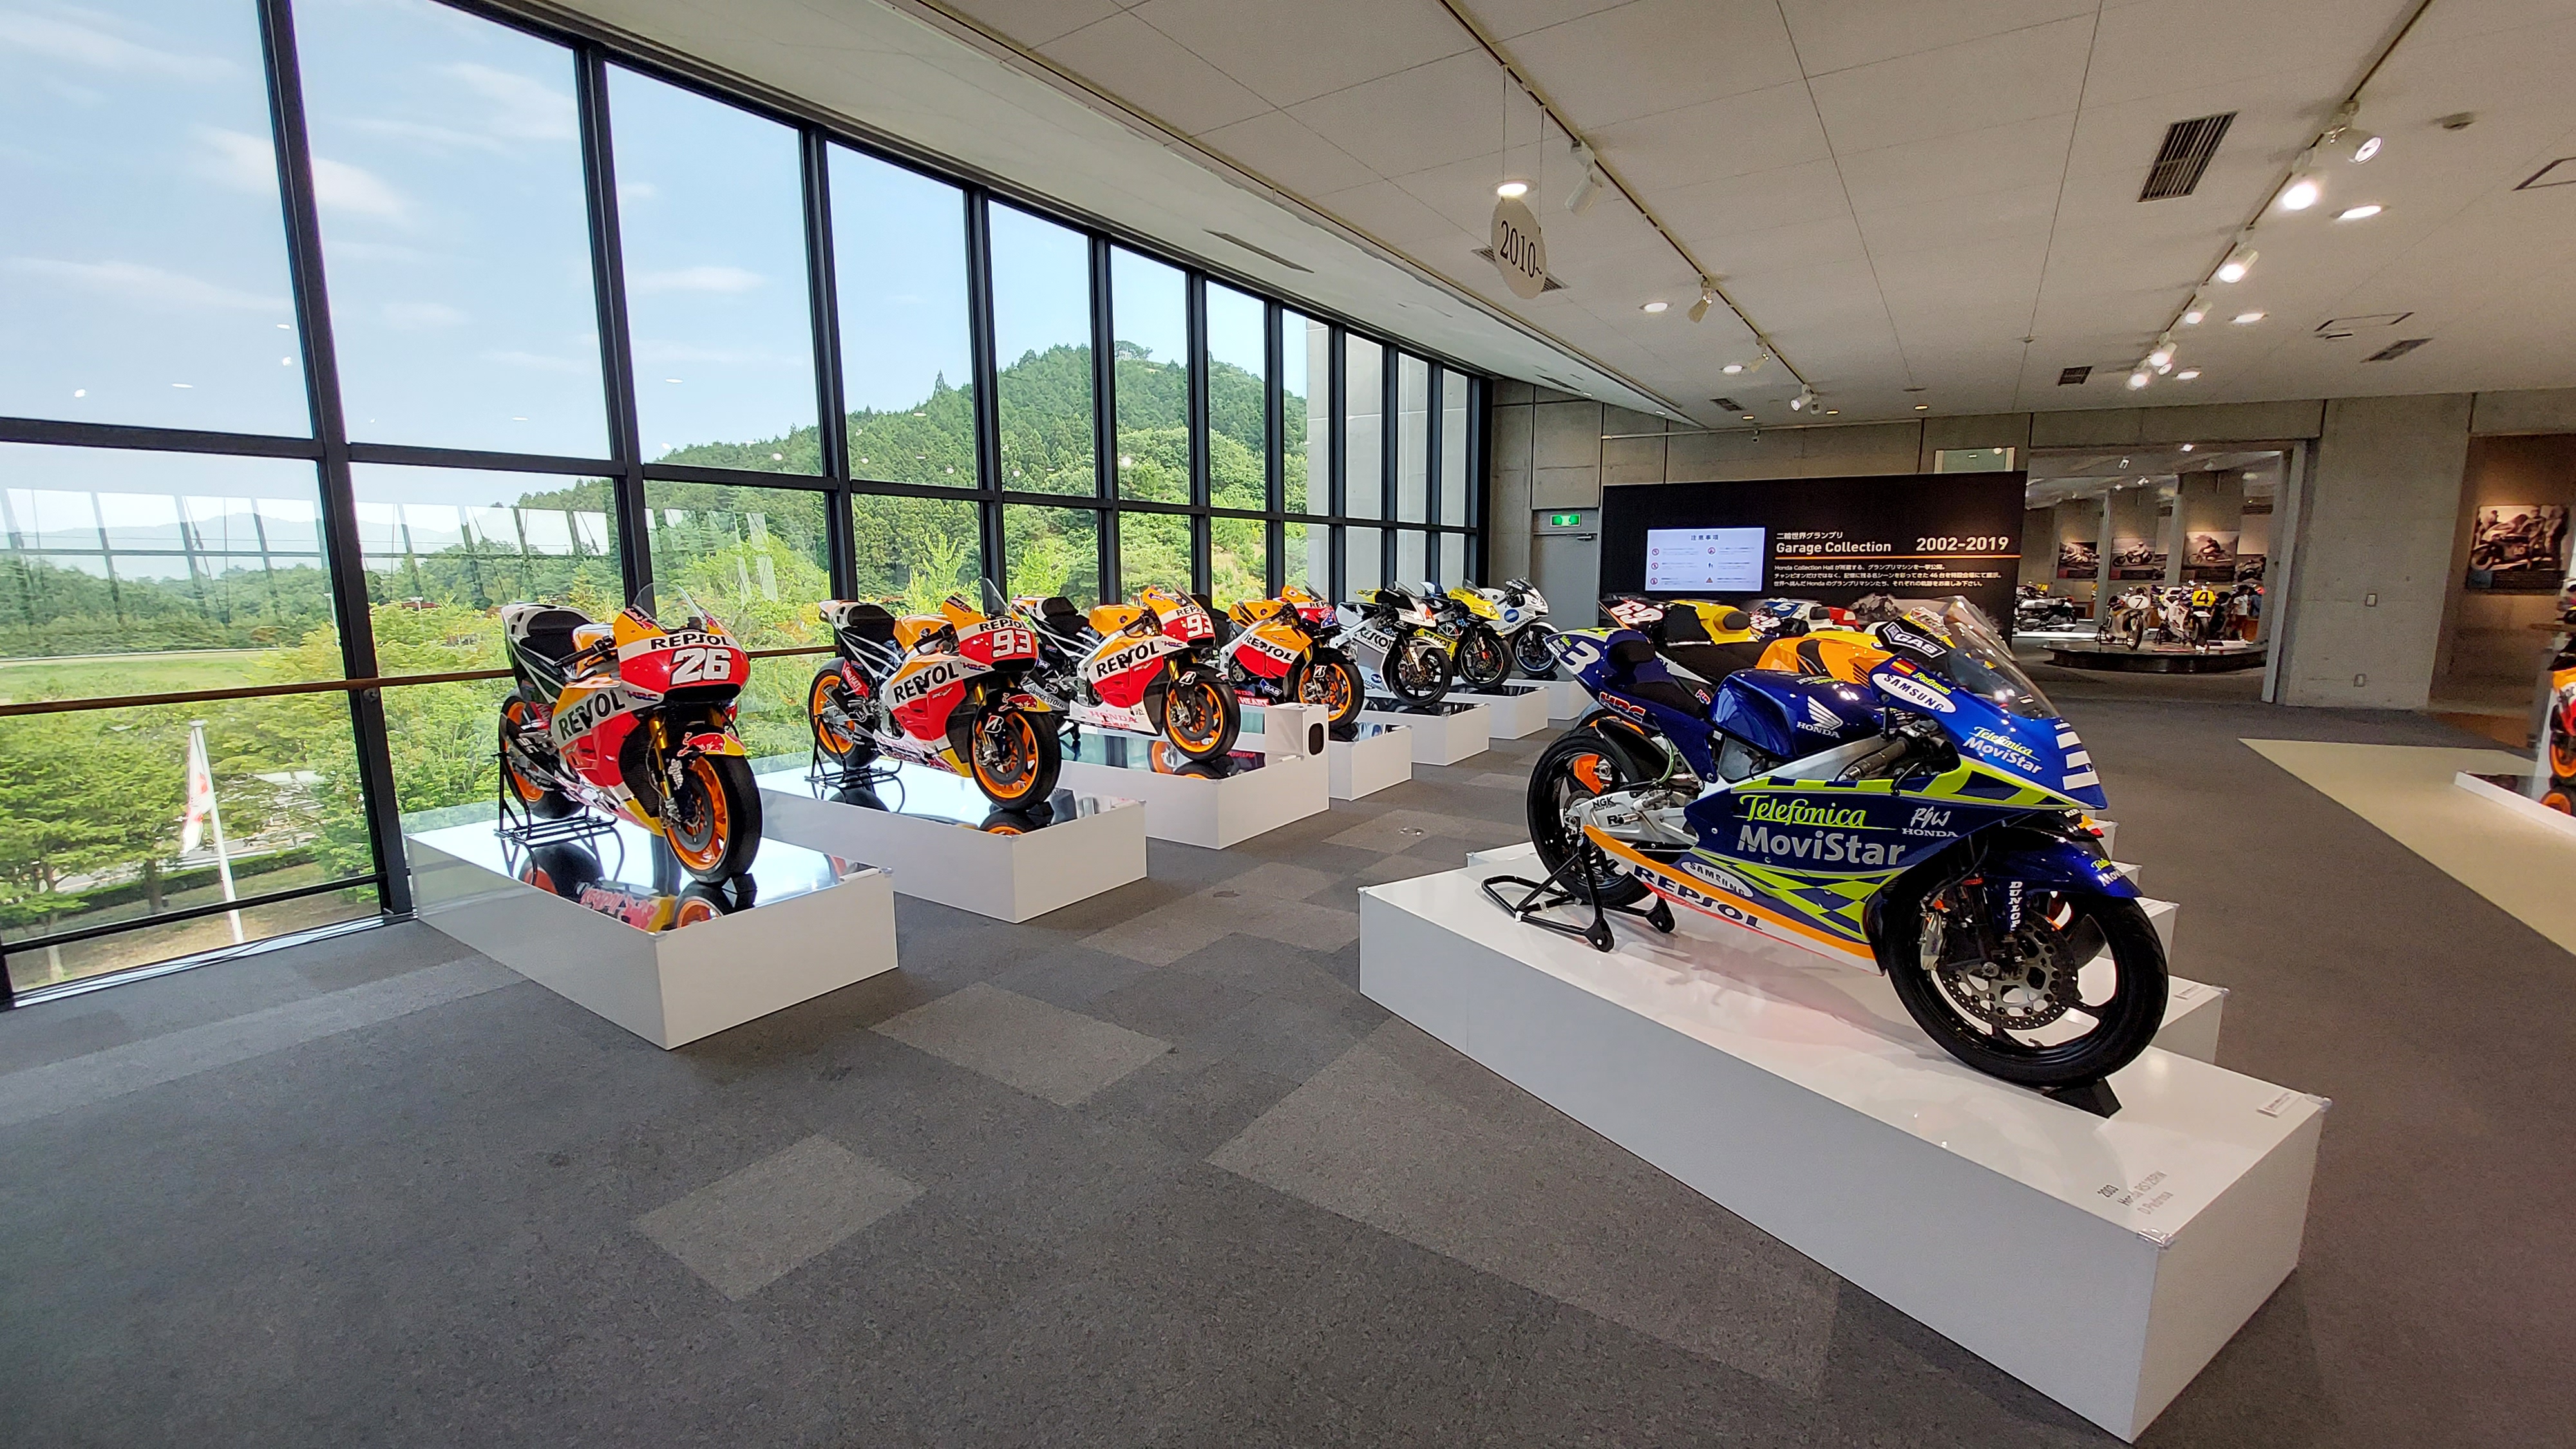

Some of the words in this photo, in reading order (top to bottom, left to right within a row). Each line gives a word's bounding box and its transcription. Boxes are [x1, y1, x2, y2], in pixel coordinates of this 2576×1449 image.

[1776, 531, 1843, 540] 二輪世界グランプリ
[1776, 542, 1822, 555] Garage
[1824, 542, 1891, 553] Collection
[1915, 536, 2009, 551] 2002-2019
[2135, 597, 2143, 609] 7
[2196, 591, 2210, 604] 4
[979, 620, 1028, 632] REPSOL
[1186, 614, 1214, 638] 93
[650, 634, 731, 650] REPSOL
[992, 629, 1032, 658] 93
[1244, 634, 1294, 662] REPSOL
[1894, 632, 1938, 654] GAS
[670, 648, 732, 686] 26
[1565, 640, 1600, 674] 3
[1884, 674, 1944, 711] SAMSUNG
[1912, 672, 1951, 695] Pedrosa
[1599, 692, 1646, 723] HRC
[1796, 721, 1841, 739] HONDA
[1962, 736, 2043, 773] MoviStar
[1592, 796, 1615, 809] NGK
[1901, 827, 1959, 838] HONDA
[1737, 824, 1906, 866] MoviStar
[1689, 862, 1745, 896] SAMSUNG
[1633, 864, 1763, 931] REPSOL
[2007, 881, 2023, 931] DUNLOP
